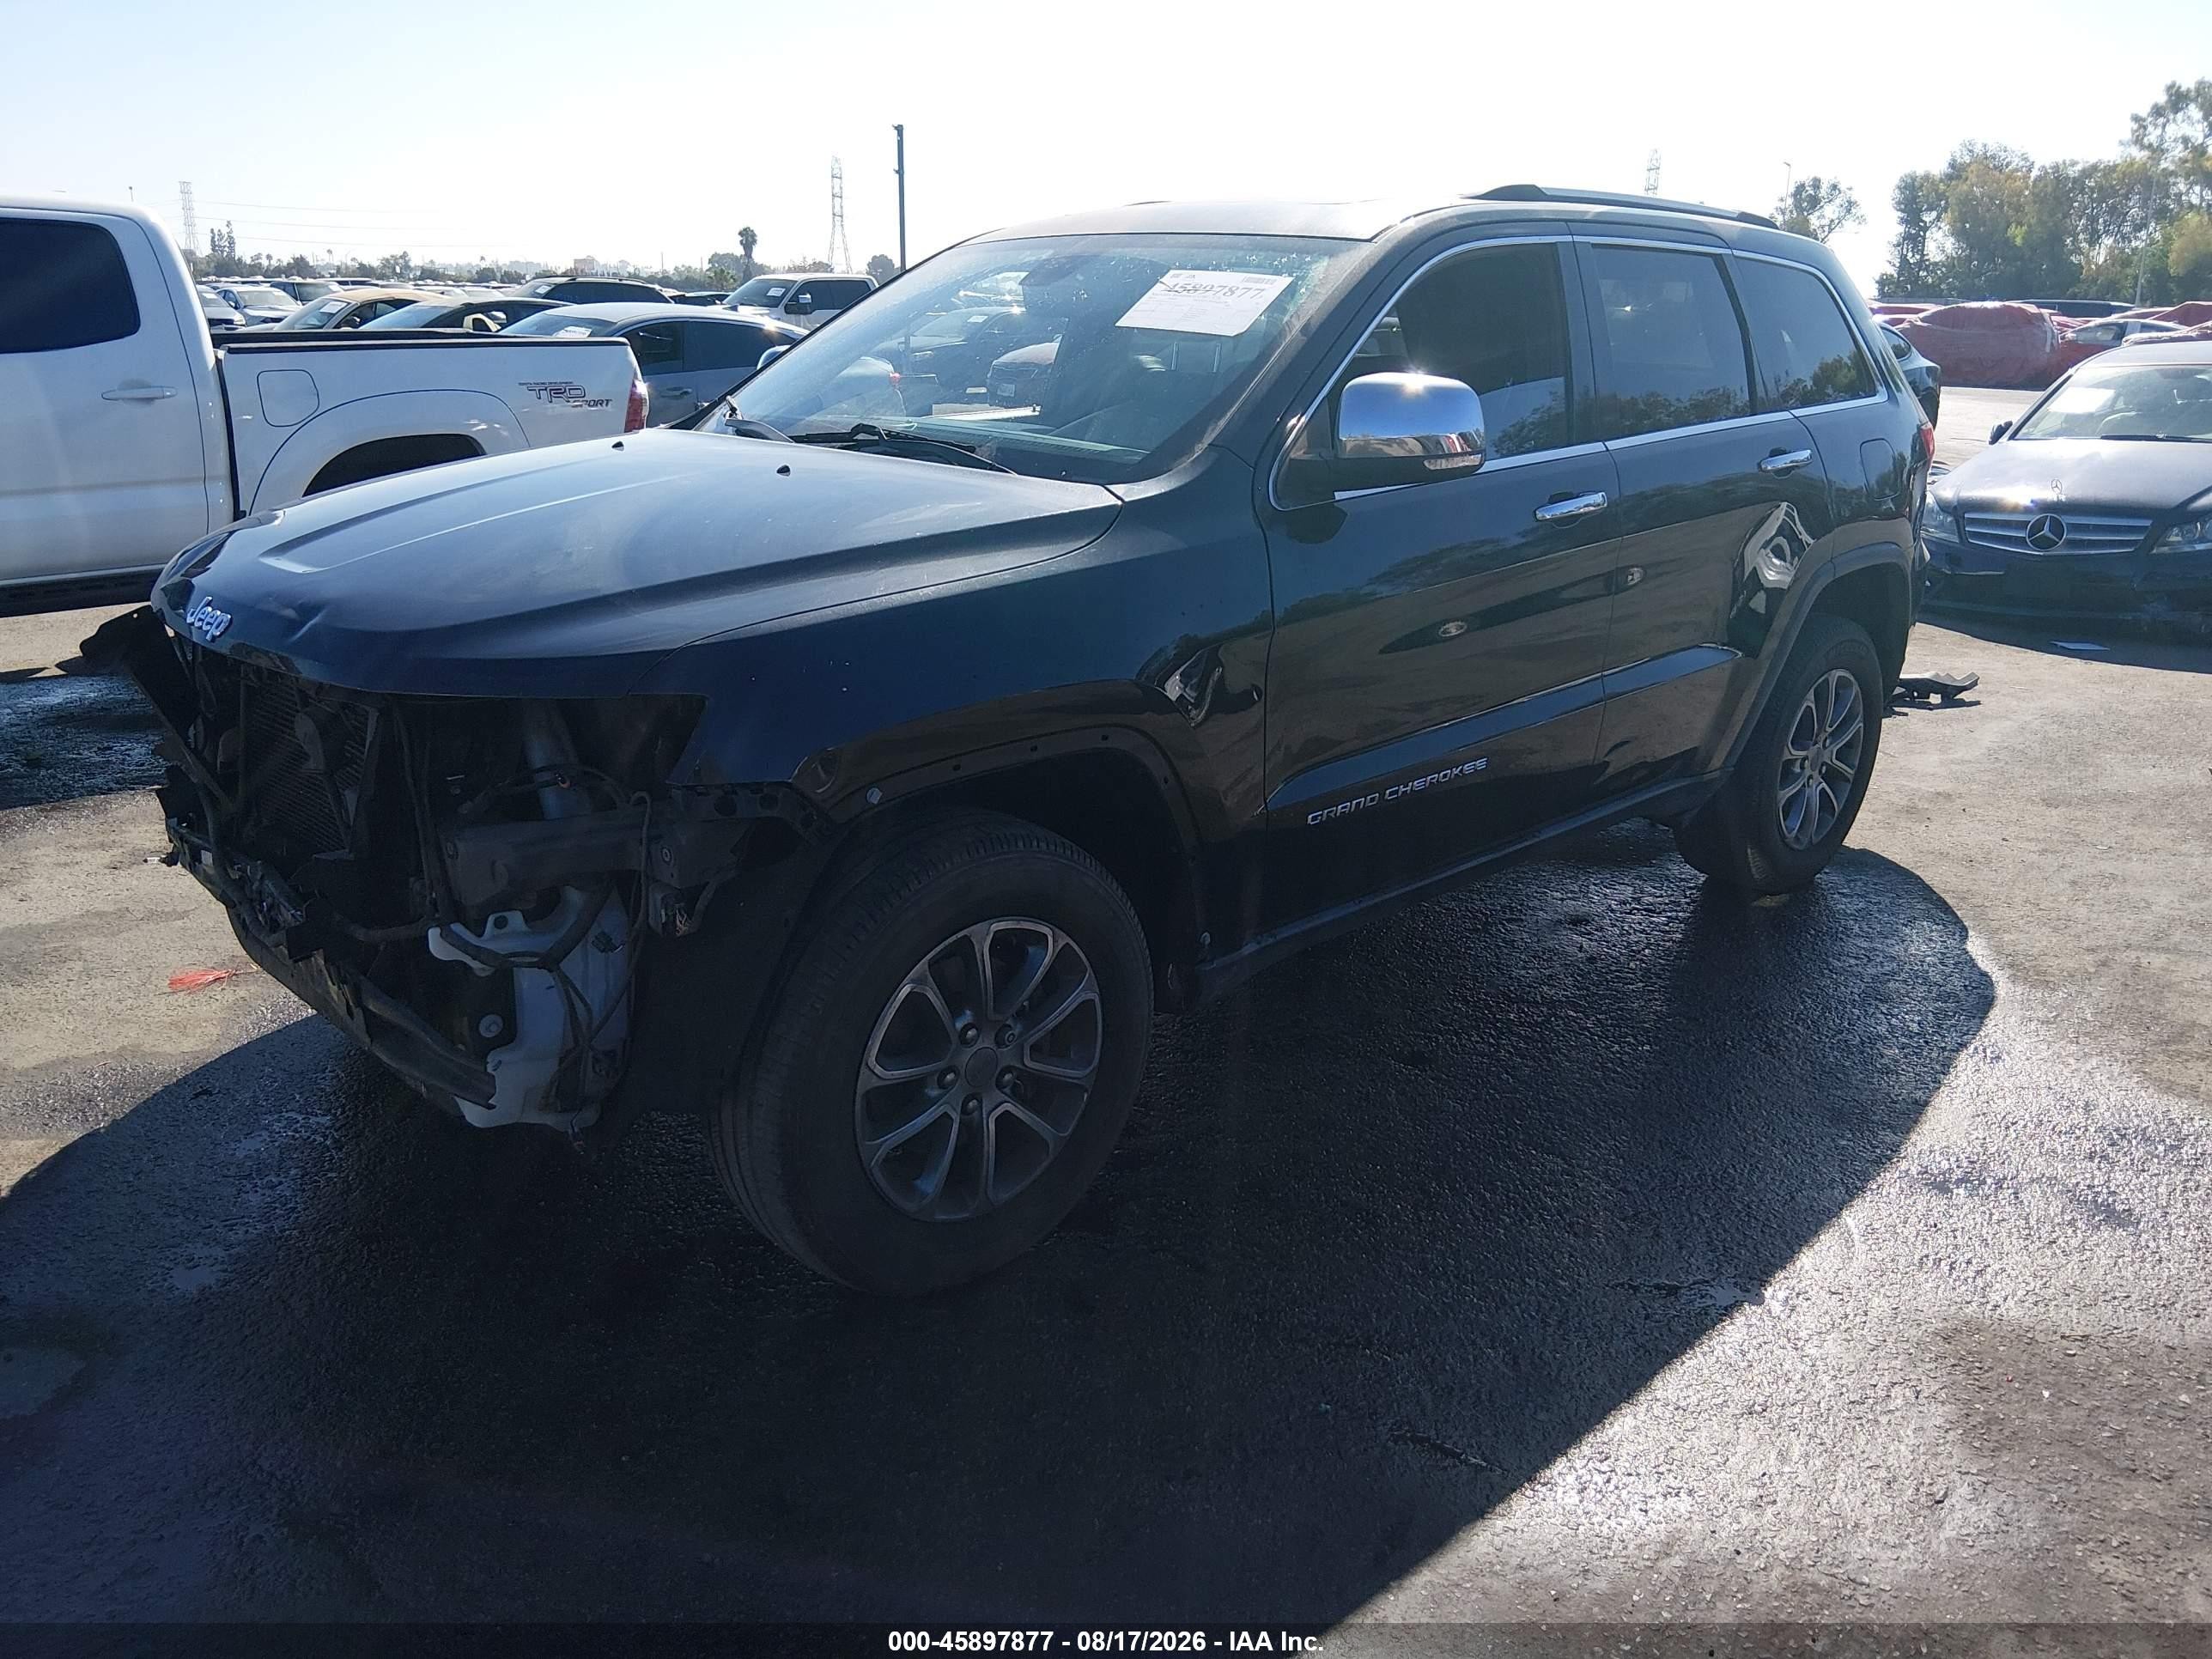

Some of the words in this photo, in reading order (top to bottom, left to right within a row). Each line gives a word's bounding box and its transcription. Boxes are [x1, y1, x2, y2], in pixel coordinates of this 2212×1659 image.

[527, 386, 586, 403] TRD
[571, 399, 612, 408] SPORT
[186, 596, 232, 641] Jeep
[1306, 793, 1380, 825] GRAND
[1384, 757, 1489, 800] CHEROKEE
